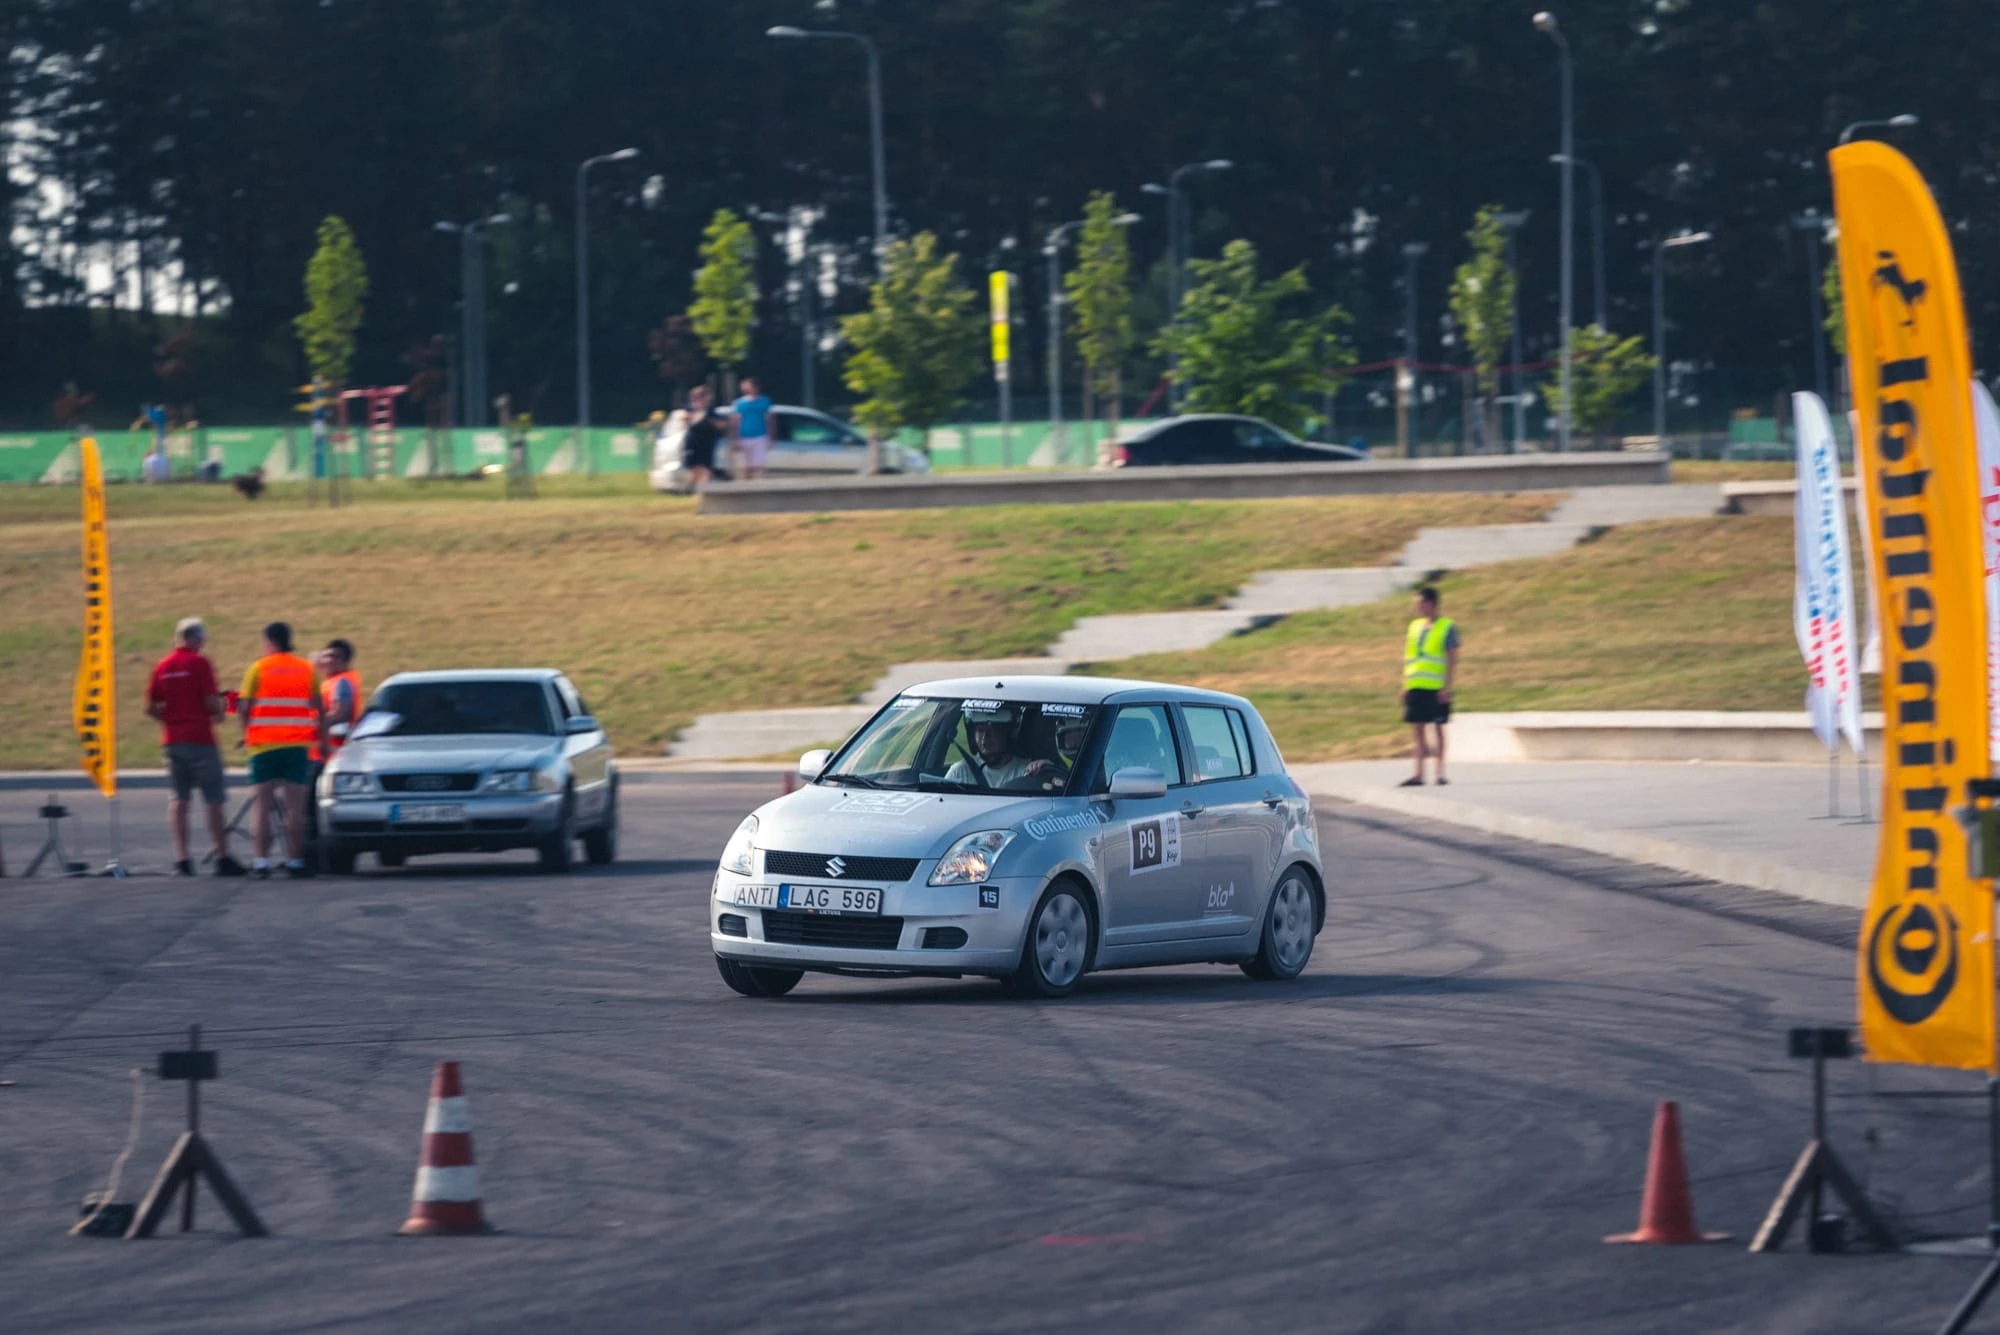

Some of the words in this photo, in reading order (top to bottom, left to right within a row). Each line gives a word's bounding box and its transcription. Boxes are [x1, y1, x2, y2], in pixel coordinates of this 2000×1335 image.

[1024, 808, 1102, 841] Continental
[1138, 828, 1156, 861] P9
[736, 887, 774, 905] ANTI
[790, 887, 830, 908] LAG
[842, 890, 877, 910] 596
[981, 890, 998, 904] 15
